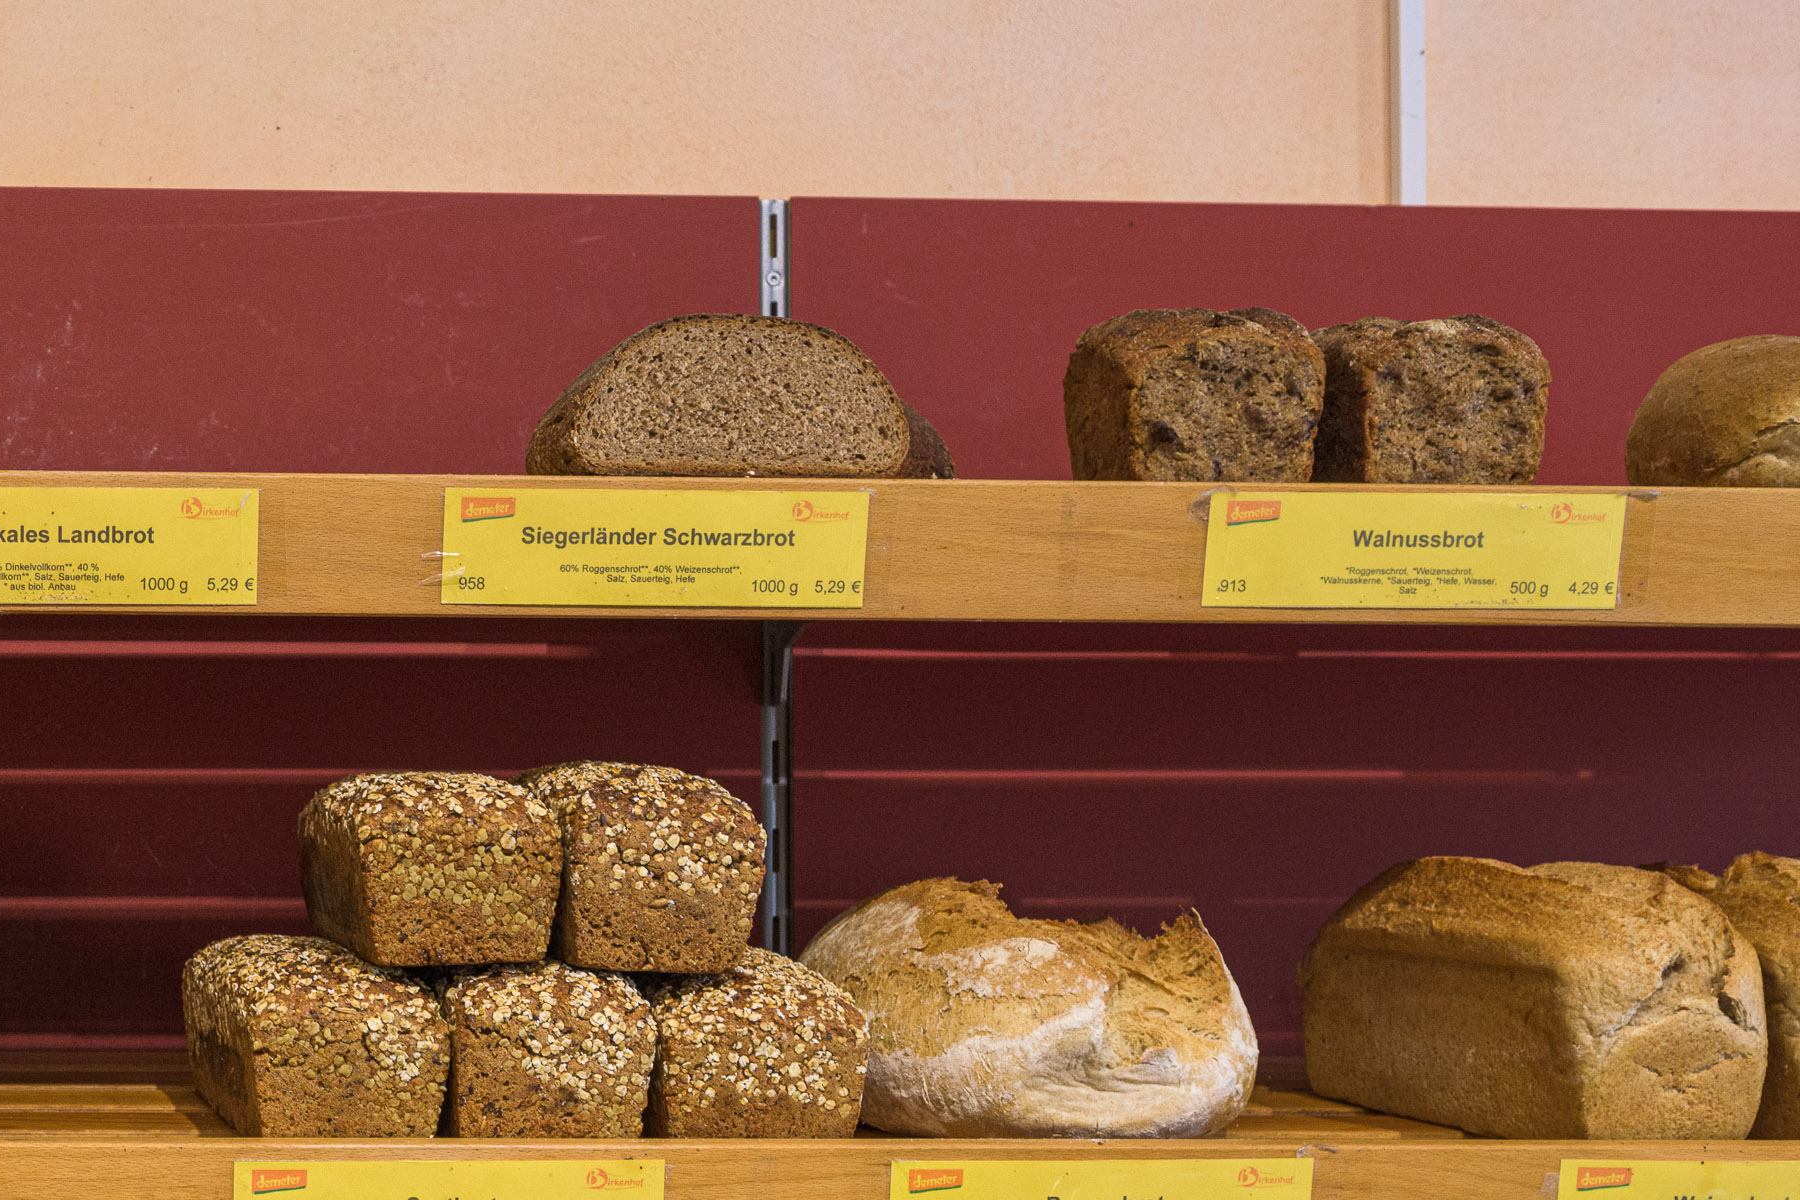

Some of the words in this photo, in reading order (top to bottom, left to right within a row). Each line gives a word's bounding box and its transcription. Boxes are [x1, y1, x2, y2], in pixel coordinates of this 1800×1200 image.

[58, 526, 154, 544] Landbrot
[522, 526, 657, 549] Siegerländer
[663, 528, 795, 546] Schwarzbrot
[1353, 530, 1484, 548] Walnussbrot
[58, 571, 101, 584] Sauerteig,
[208, 578, 238, 592] 5,29
[245, 578, 254, 591] €
[457, 575, 485, 590] 958
[141, 577, 175, 590] 1000
[180, 581, 188, 594] g
[752, 580, 785, 593] 1000
[790, 583, 798, 596] g
[815, 580, 845, 595] 5,29
[852, 581, 861, 593] €
[1217, 579, 1246, 592] 913
[1510, 581, 1536, 594] 500
[1540, 585, 1548, 597] g
[1569, 582, 1598, 595] 4,29
[1605, 582, 1614, 594] €
